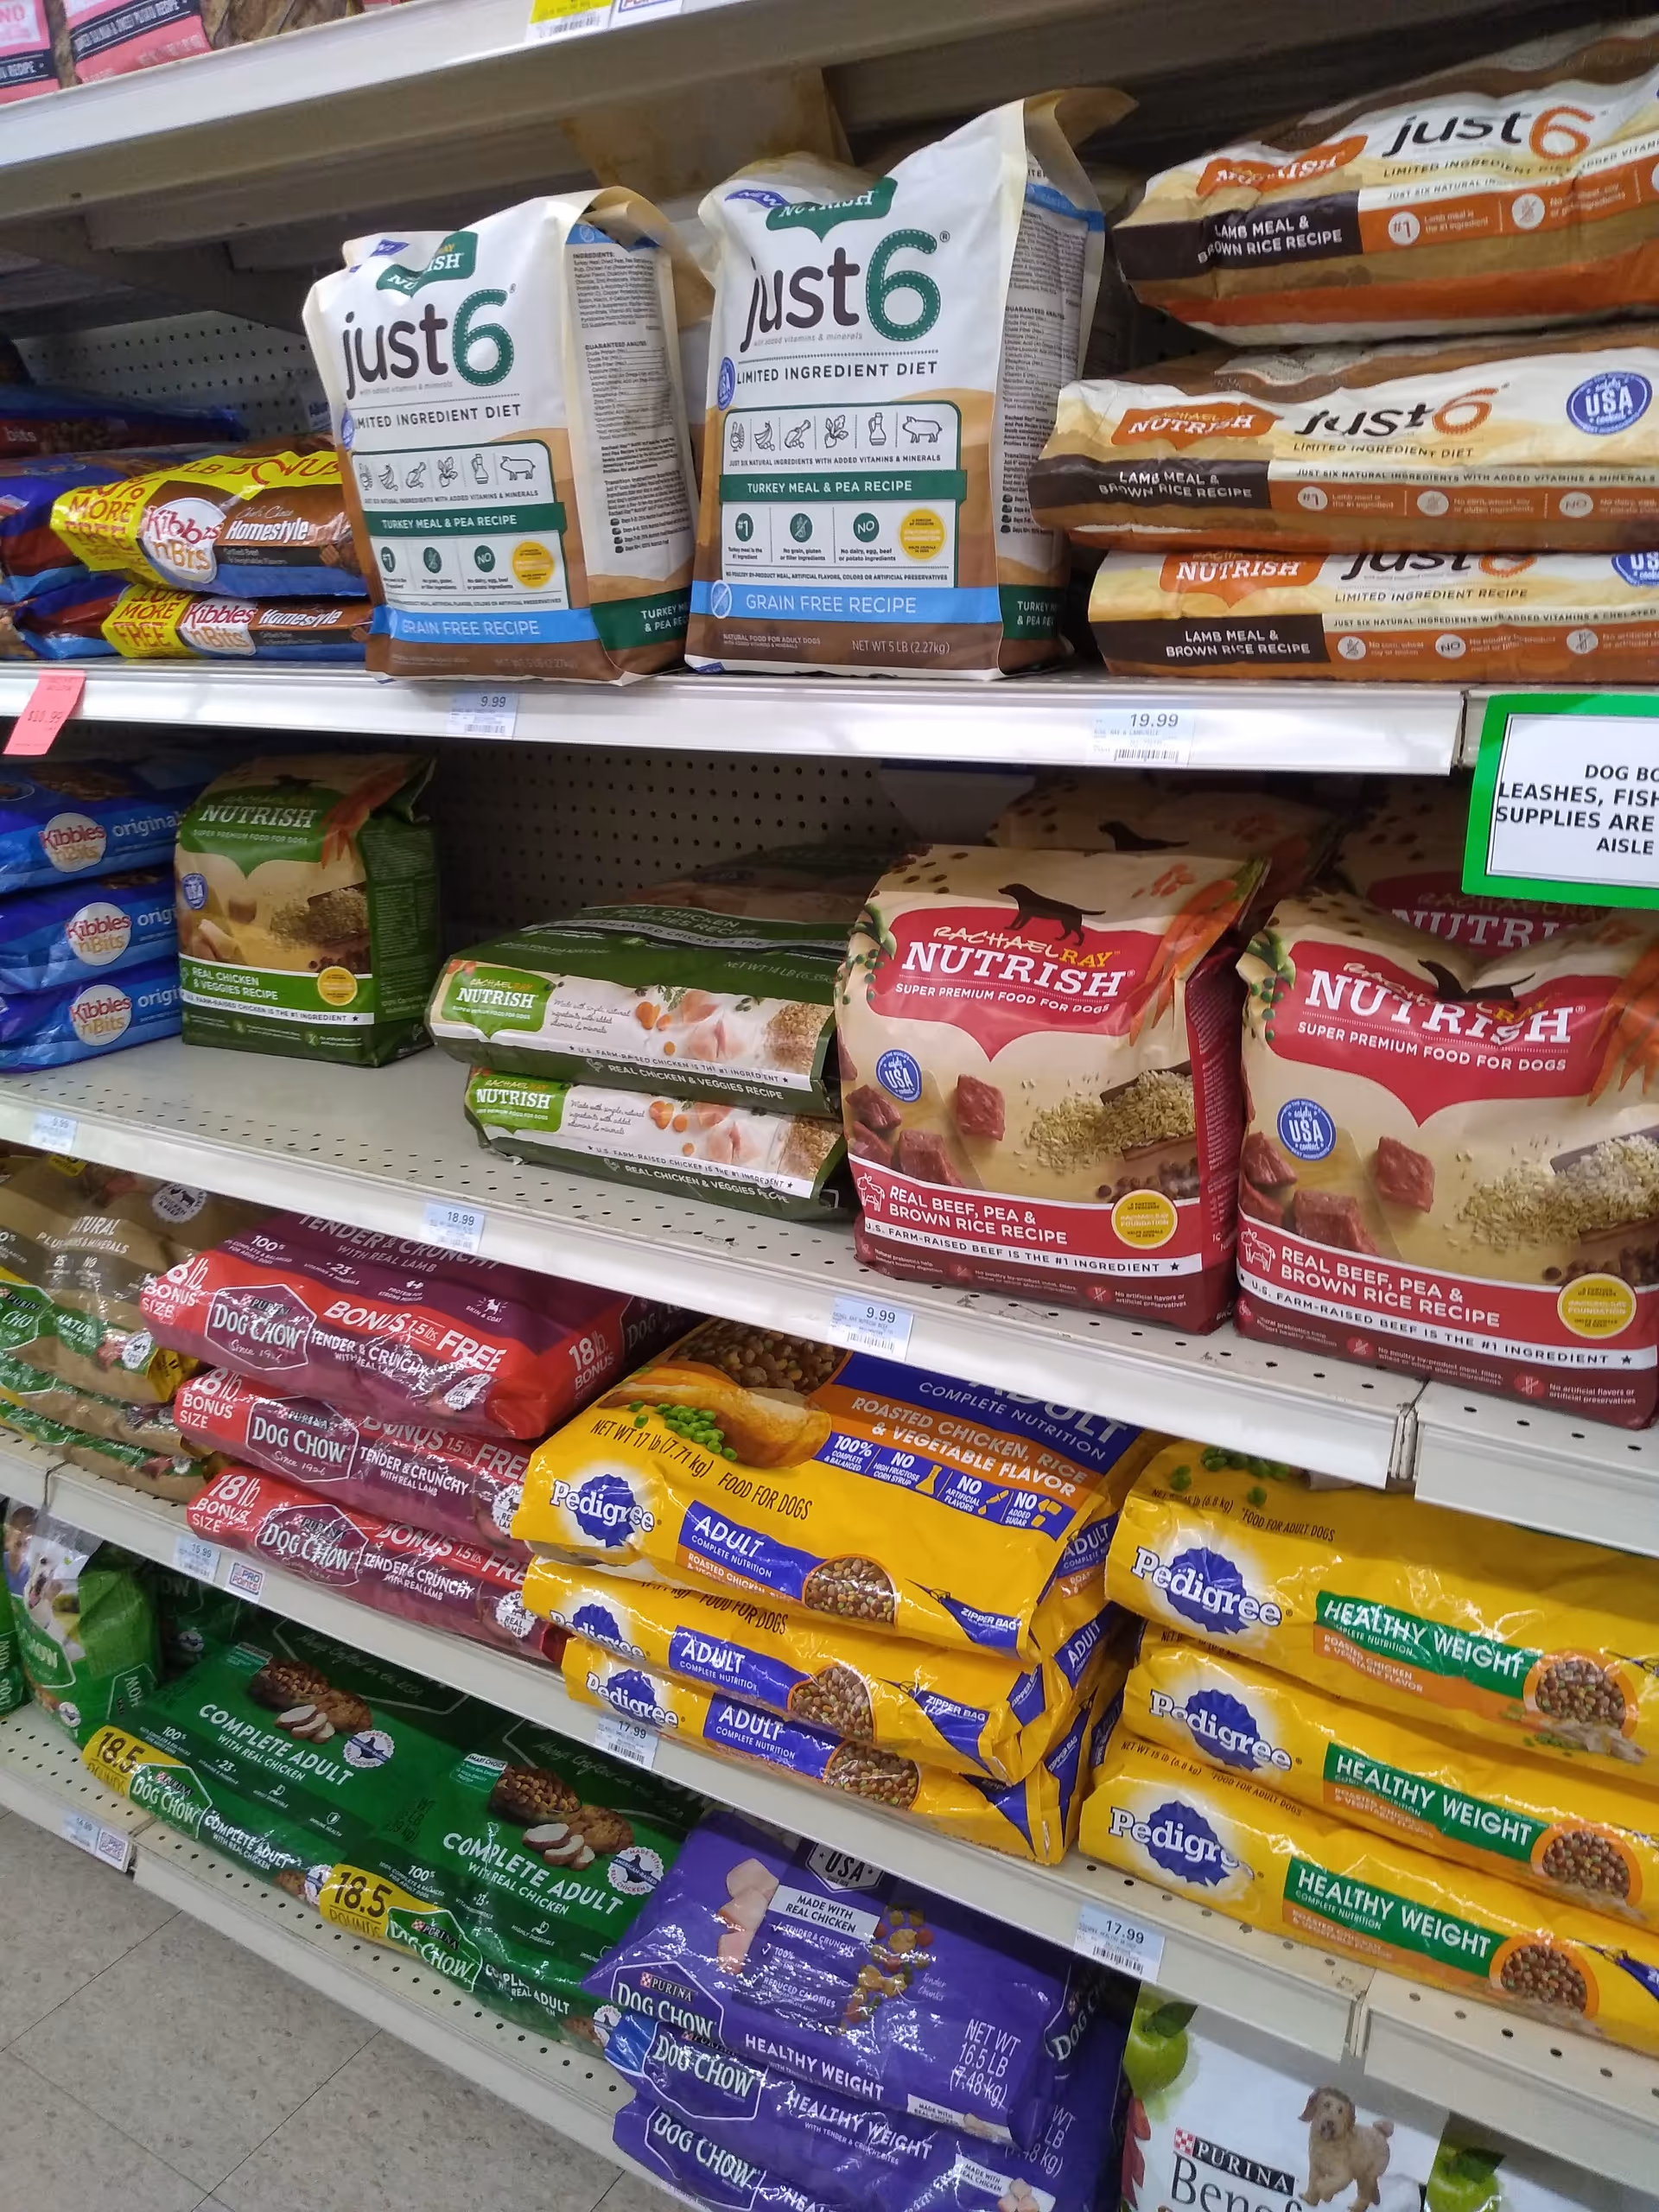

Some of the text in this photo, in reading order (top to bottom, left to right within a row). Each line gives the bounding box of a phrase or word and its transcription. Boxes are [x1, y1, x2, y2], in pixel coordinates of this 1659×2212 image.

[1215, 216, 1309, 240] LAMB MEAL &
[1247, 238, 1282, 254] RICE
[1287, 230, 1342, 249] RECIPE
[737, 361, 938, 385] LIMITED INGREDIENT DIET
[1586, 391, 1632, 416] USA
[747, 480, 912, 493] TURKEY MEAL & PEA RECIPE
[225, 518, 308, 543] Homestyle
[738, 520, 748, 537] #1
[857, 520, 874, 534] NO
[1176, 560, 1300, 582] NUTRISH
[746, 594, 916, 613] GRAIN FREE RECIPE
[184, 606, 257, 627] Kibbles
[852, 640, 869, 652] NET
[871, 641, 887, 652] WT
[889, 641, 895, 652] 5
[897, 641, 908, 653] LB
[1185, 630, 1279, 642] LAMB MEAL &
[1166, 642, 1311, 658] BROWN RICE RECIPE
[480, 695, 506, 709] 9.99
[1129, 713, 1179, 728] 19.99
[1585, 764, 1629, 780] DOG
[1498, 782, 1603, 807] LEASHES,
[199, 804, 317, 829] NUTRISH
[1496, 806, 1654, 832] SUPPLIES ARE
[1597, 837, 1654, 855] AISLE
[66, 912, 131, 943] Kibbles
[933, 925, 1112, 969] RACHAEL RAY
[900, 941, 1126, 998] NUTRISH
[69, 997, 132, 1023] Kibbles
[456, 988, 536, 1009] NUTRISH
[895, 982, 1110, 1014] SUPER PREMIUM FOOD FOR DOGS
[607, 1065, 784, 1100] REAL CHICKEN & VEGGIES RECIPE
[1288, 1116, 1325, 1141] USA
[889, 1185, 1036, 1224] REAL BEEF, PEA &
[447, 1211, 474, 1226] 18.99
[889, 1204, 1068, 1245] BROWN RICE RECIPE
[888, 1228, 967, 1251] FARM-RAISED
[972, 1243, 1003, 1256] BEEF
[1008, 1249, 1020, 1259] IS
[1025, 1251, 1050, 1263] THE
[1055, 1255, 1069, 1266] #1
[1074, 1259, 1160, 1273] INGREDIENT
[866, 1306, 896, 1324] 9.99
[181, 1393, 234, 1420] BONUS
[179, 1411, 209, 1429] SIZE
[918, 1382, 1106, 1461] COMPLETE NUTRITION
[252, 1416, 348, 1464] DOG CHOW
[590, 1419, 613, 1437] NET
[614, 1424, 633, 1442] WT
[636, 1431, 648, 1446] 17
[691, 1457, 715, 1479] kg)
[834, 1434, 873, 1458] 100%
[852, 1396, 1088, 1483] ROASTED CHICKEN, RICE
[359, 1446, 470, 1496] TENDER & CRUNCHY
[872, 1421, 1077, 1497] & VEGETABLE FLAVOR
[893, 1452, 915, 1468] NO
[379, 1468, 438, 1497] WITH REAL LAMB
[873, 1462, 920, 1482] HIGH FRUCTOSE
[873, 1471, 912, 1486] CORN SYRUP
[718, 1472, 813, 1521] FOOD FOR DOGS
[945, 1488, 980, 1506] ARTIFICIAL
[957, 1475, 982, 1495] NO
[550, 1479, 656, 1533] Pedigree
[944, 1498, 975, 1513] FLAVORS
[1014, 1491, 1037, 1510] NO
[1005, 1516, 1027, 1527] SUGAR
[1008, 1509, 1031, 1519] ADDED
[694, 1516, 764, 1558] ADULT
[691, 1535, 772, 1579] COMPLETE NUTRITION
[241, 1568, 260, 1585] PRO
[1131, 1545, 1282, 1628] Pedigree
[1324, 1599, 1524, 1678] HEALTHY WEIGHT
[619, 1719, 647, 1740] 17.99
[1149, 1689, 1293, 1771] Pedigree
[199, 1704, 355, 1786] COMPLETE ADULT
[217, 1734, 306, 1783] WITH REAL CHICKEN
[331, 1871, 393, 1919] 18.5
[797, 1895, 854, 1920] MADE WITH
[785, 1903, 856, 1934] REAL CHICKEN
[1298, 1868, 1491, 1959] HEALTHY WEIGHT
[1105, 1918, 1145, 1945] 17.99
[652, 1979, 693, 2003] PURINA
[617, 1982, 715, 2037] DOG CHOW
[965, 2018, 1021, 2056] NET WT
[745, 2033, 885, 2101] HEALTHY WEIGHT
[960, 2042, 1009, 2077] 16.5 LB
[1195, 2140, 1296, 2196] PURINA
